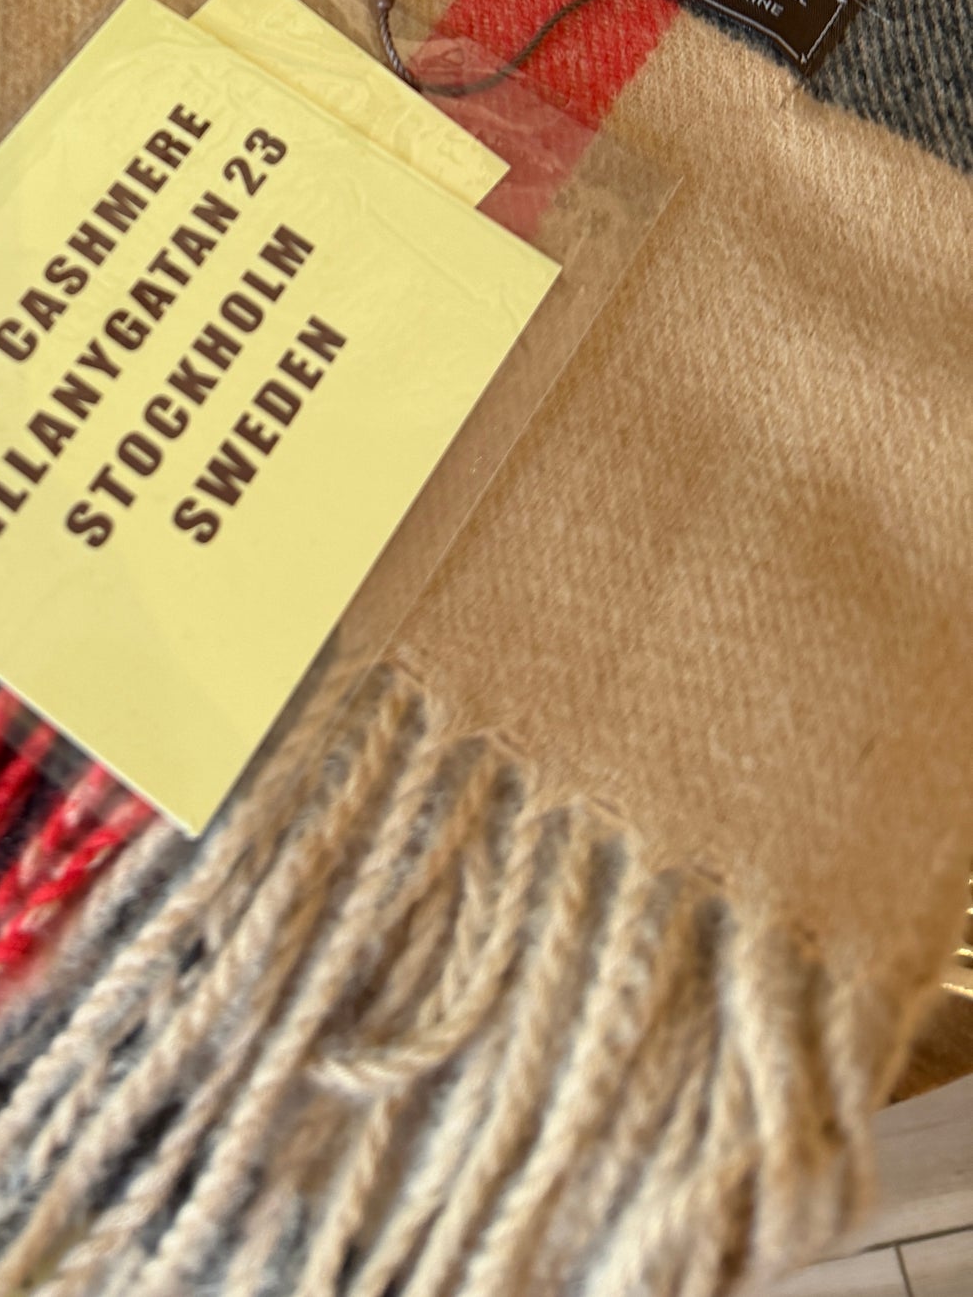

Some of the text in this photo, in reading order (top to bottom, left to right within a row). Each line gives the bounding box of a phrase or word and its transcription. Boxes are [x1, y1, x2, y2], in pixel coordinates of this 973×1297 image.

[222, 127, 289, 197] 23
[65, 223, 316, 549] STOCKHOLM
[173, 314, 348, 545] SWEDEN
